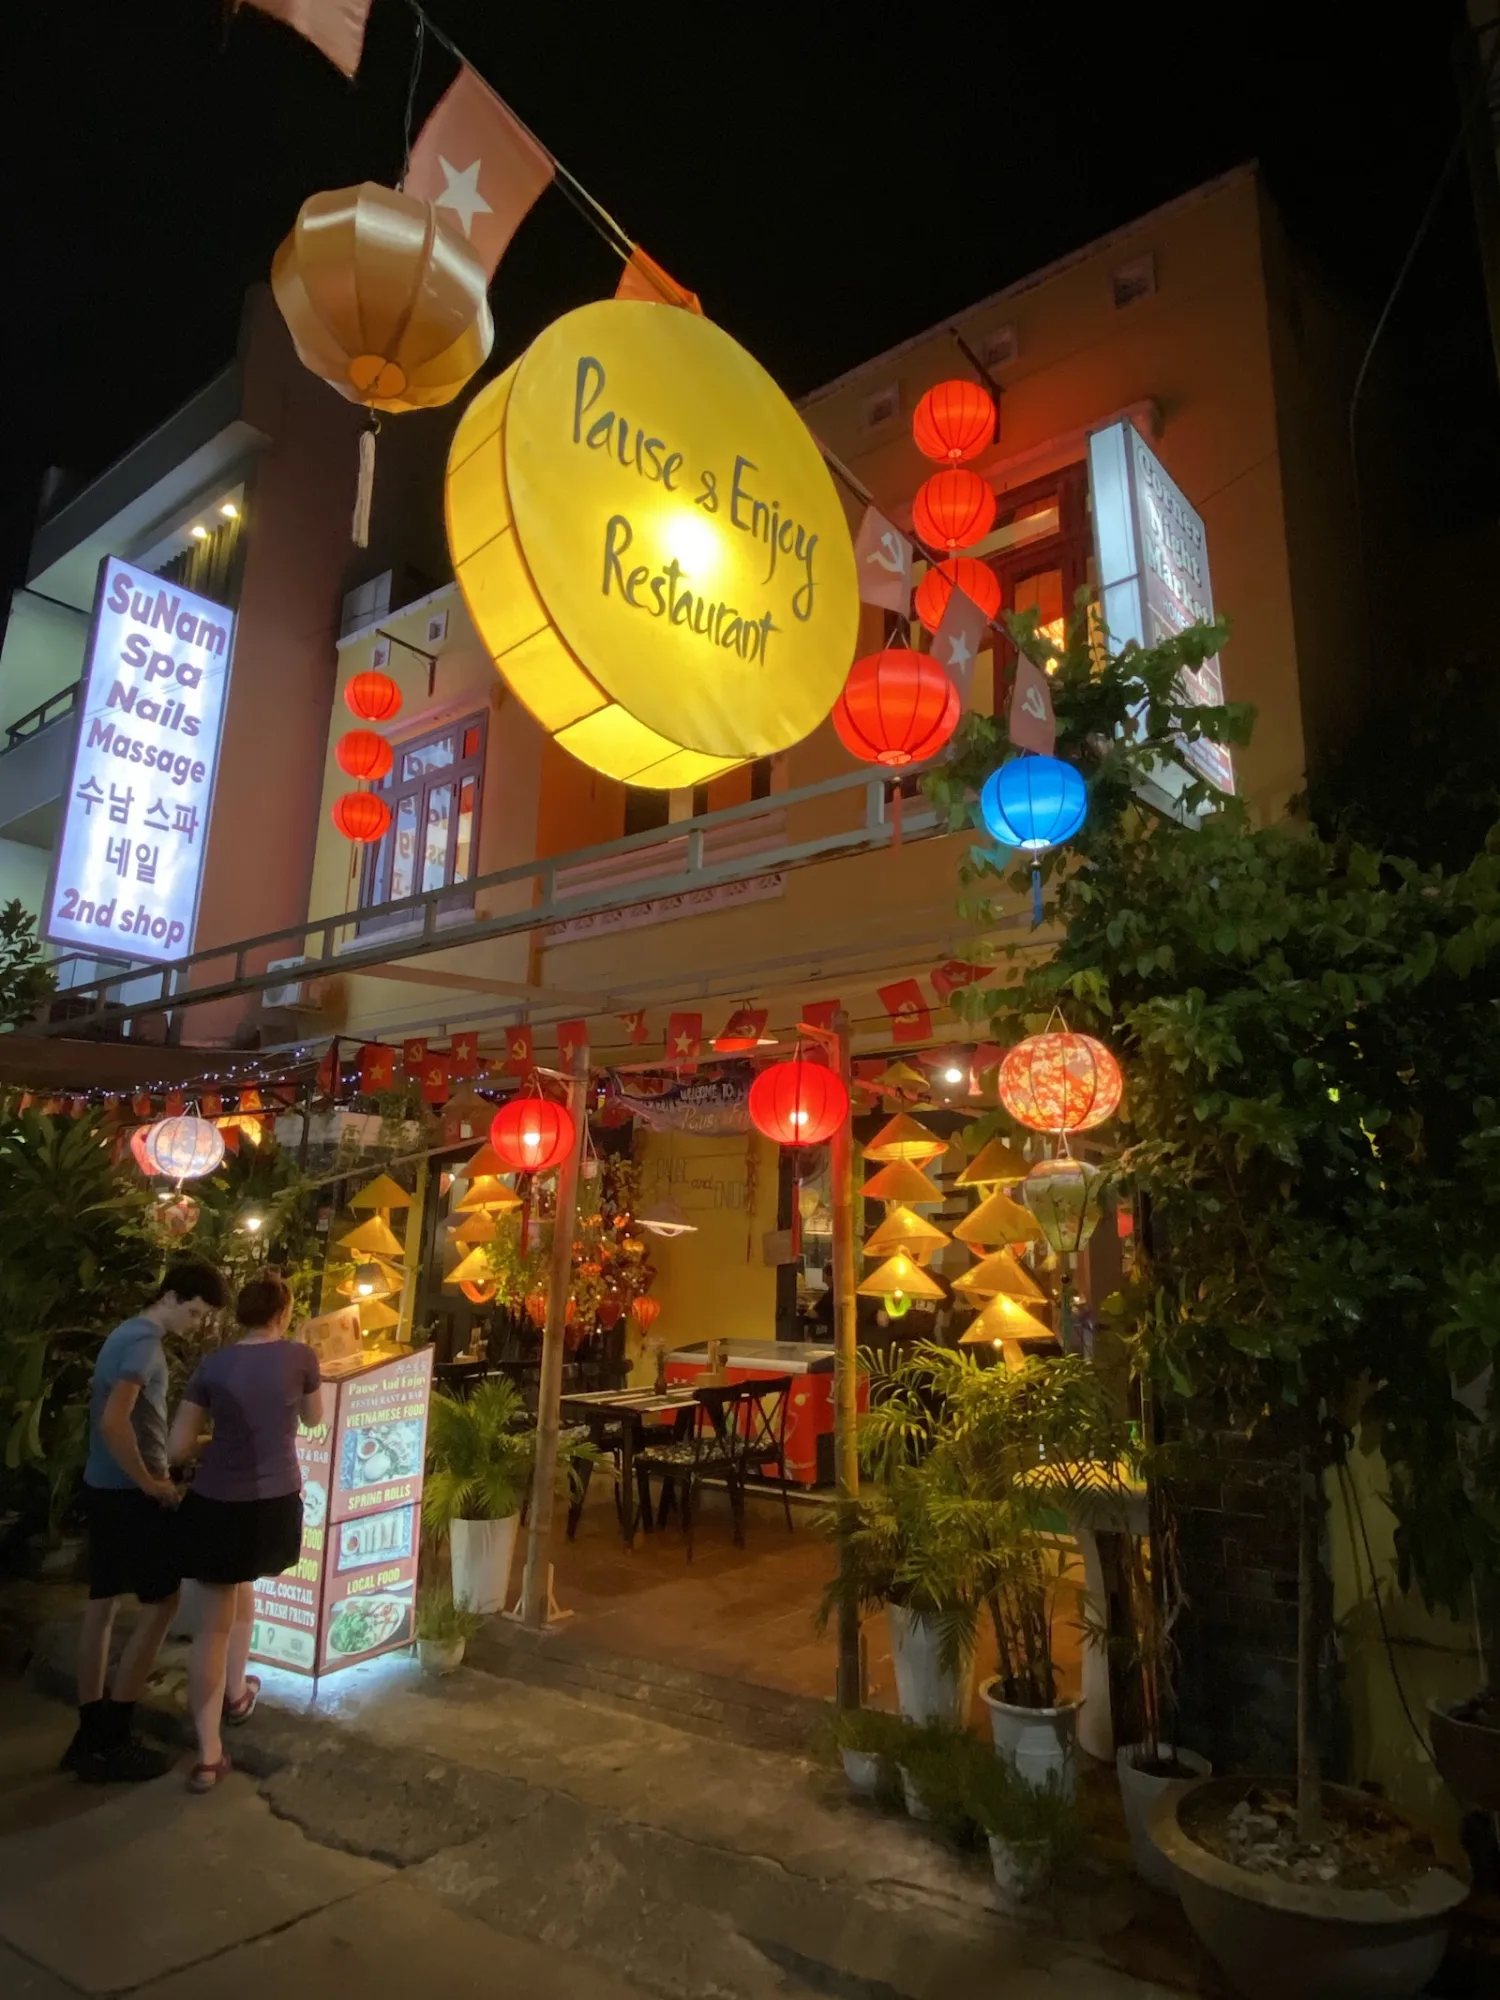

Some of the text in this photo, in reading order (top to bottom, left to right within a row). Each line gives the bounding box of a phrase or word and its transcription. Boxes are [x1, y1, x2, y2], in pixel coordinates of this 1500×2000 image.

[573, 356, 819, 621] Pause & Enjoy
[107, 572, 227, 657] SuNam
[602, 514, 783, 667] Restaurant
[120, 632, 203, 691] Spa
[106, 680, 201, 737] Nails
[86, 717, 206, 786] Massage
[75, 774, 199, 844] 수남 스파
[105, 836, 160, 884] 네일
[57, 887, 185, 949] 2nd shop
[348, 1382, 379, 1396] Pause
[401, 1374, 426, 1389] Enjoy
[346, 1403, 425, 1428] VIETNAMESE FOOD
[313, 1450, 329, 1464] BAR
[348, 1483, 411, 1511] SPRING ROLLS
[302, 1526, 323, 1551] FOOD
[253, 1577, 313, 1605] OFFEE, COCKTAIL
[298, 1557, 318, 1582] FOOD
[347, 1567, 400, 1596] LOCAL FOOD
